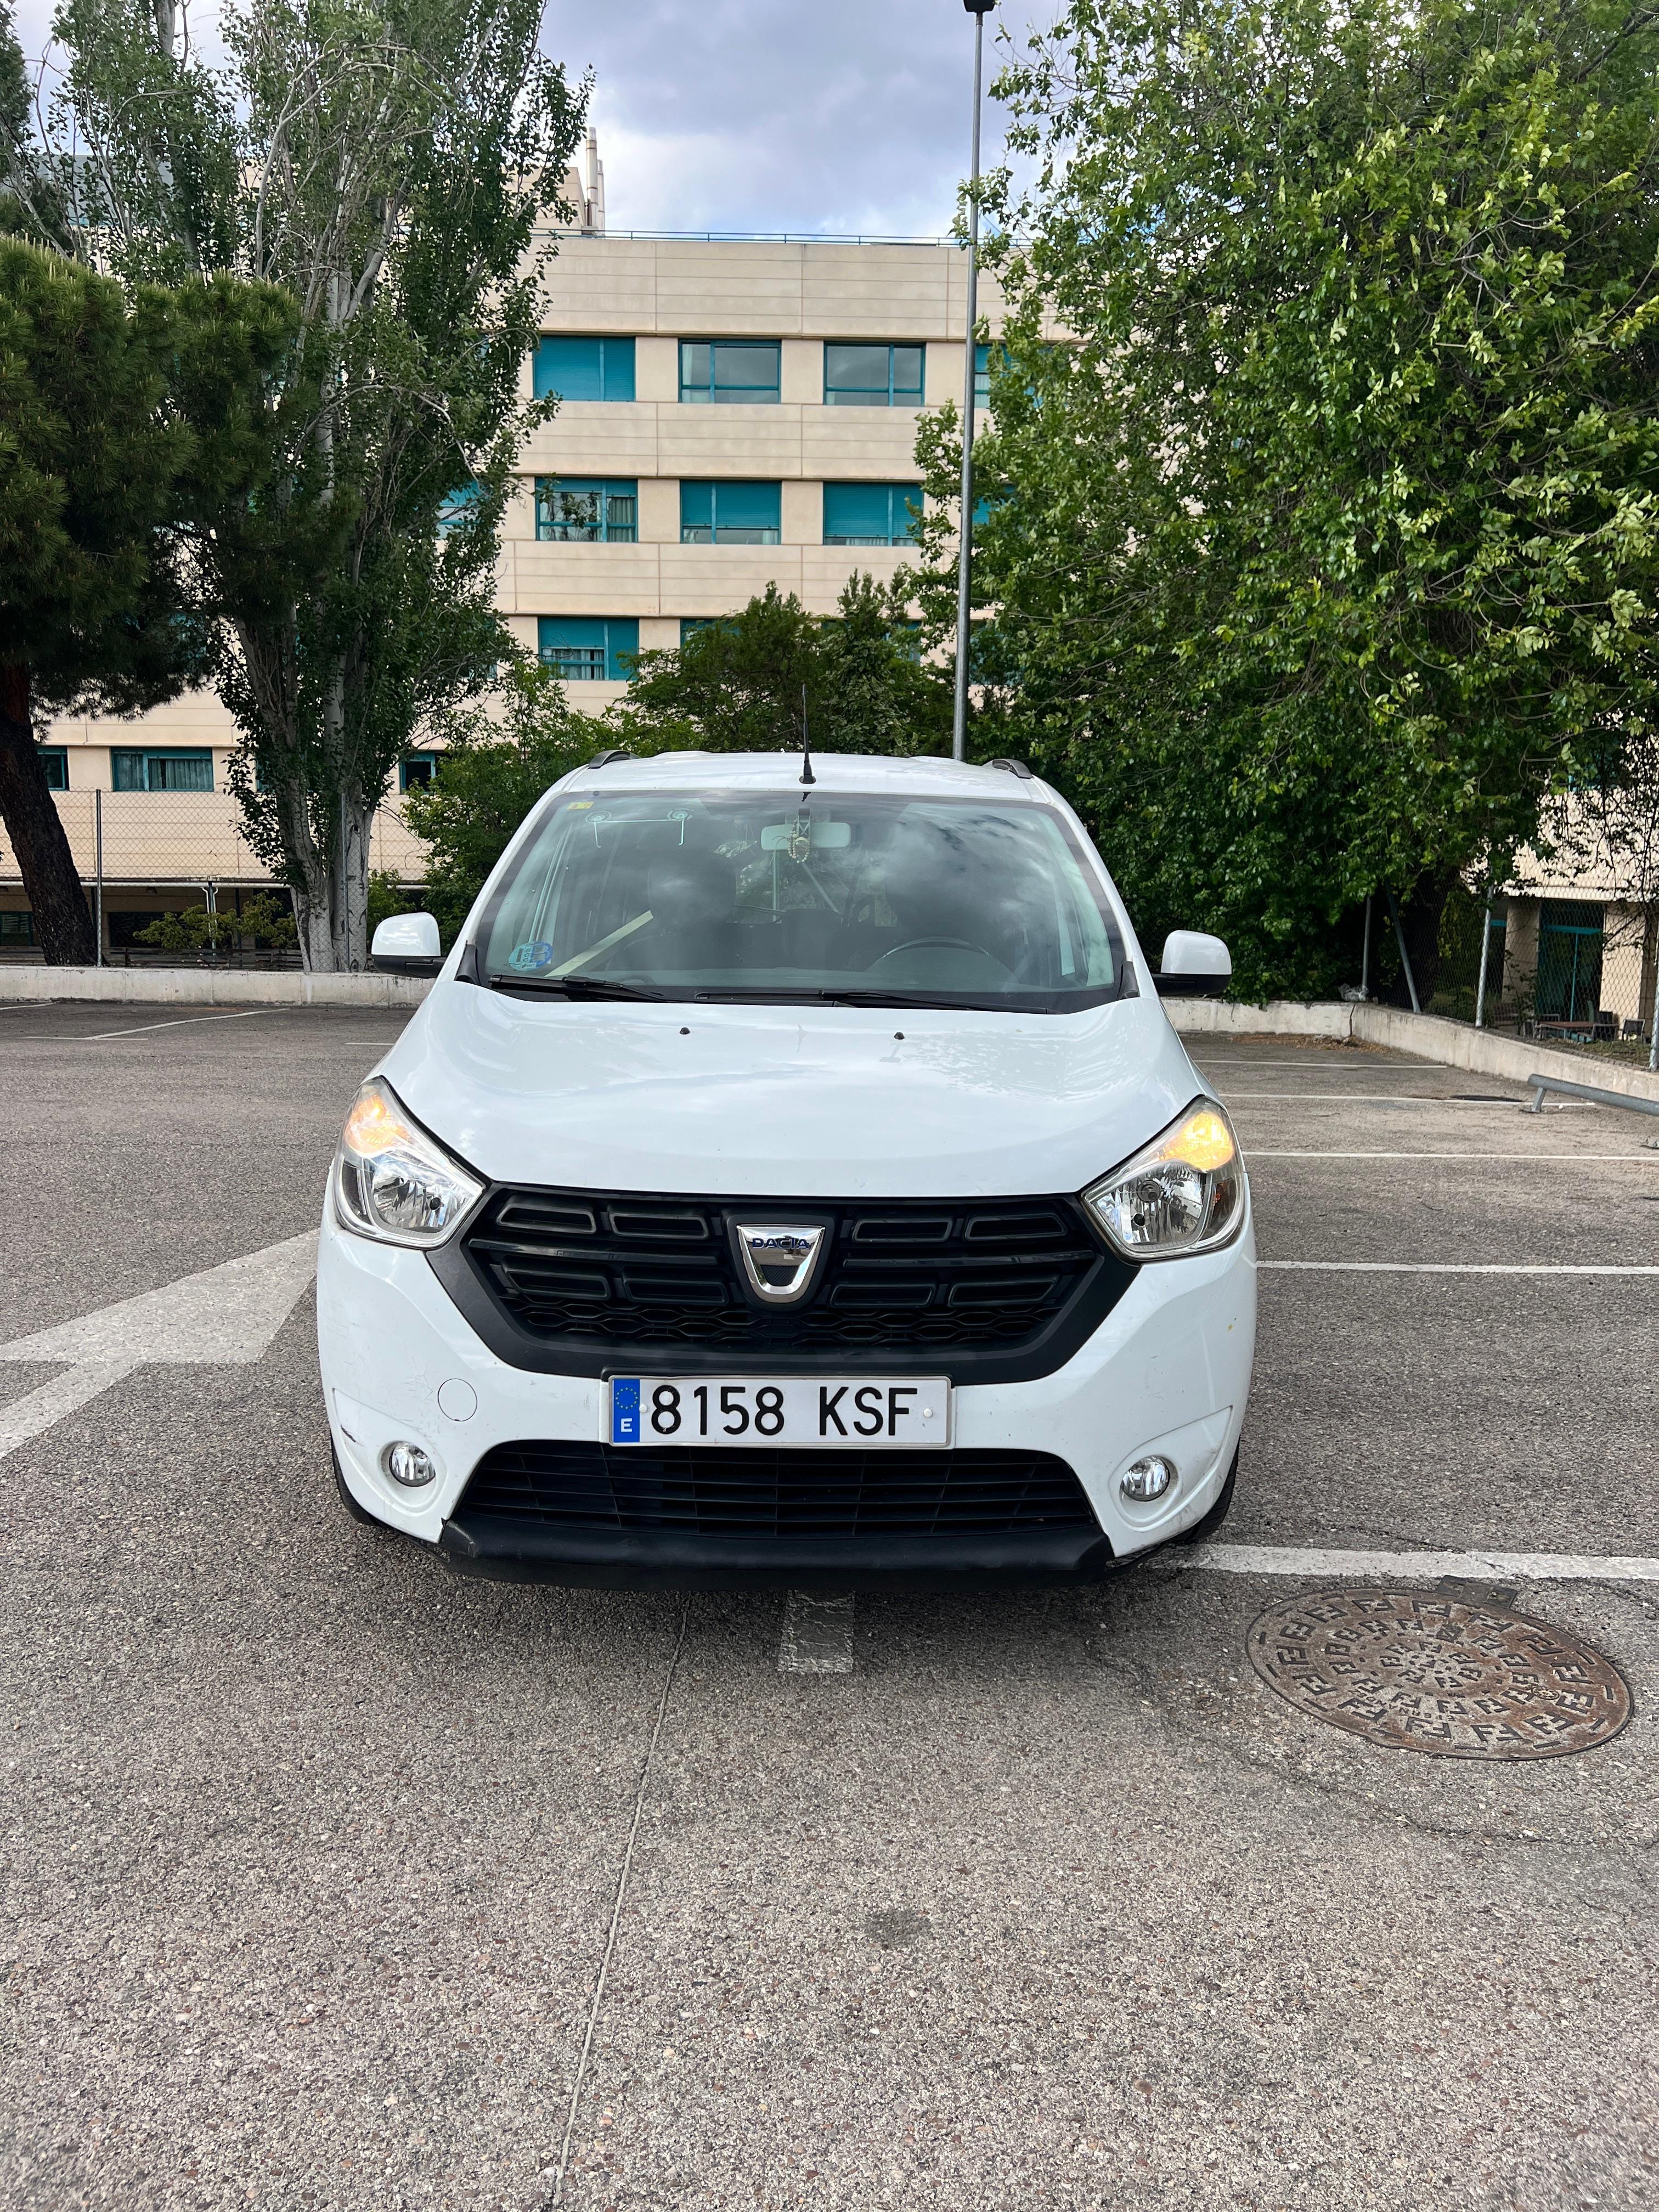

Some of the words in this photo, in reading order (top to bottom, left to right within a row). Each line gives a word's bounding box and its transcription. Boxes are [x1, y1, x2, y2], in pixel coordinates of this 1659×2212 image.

[752, 1238, 810, 1249] DACIA
[651, 1385, 785, 1436] 8158
[819, 1386, 918, 1436] KSF
[620, 1418, 633, 1432] E
